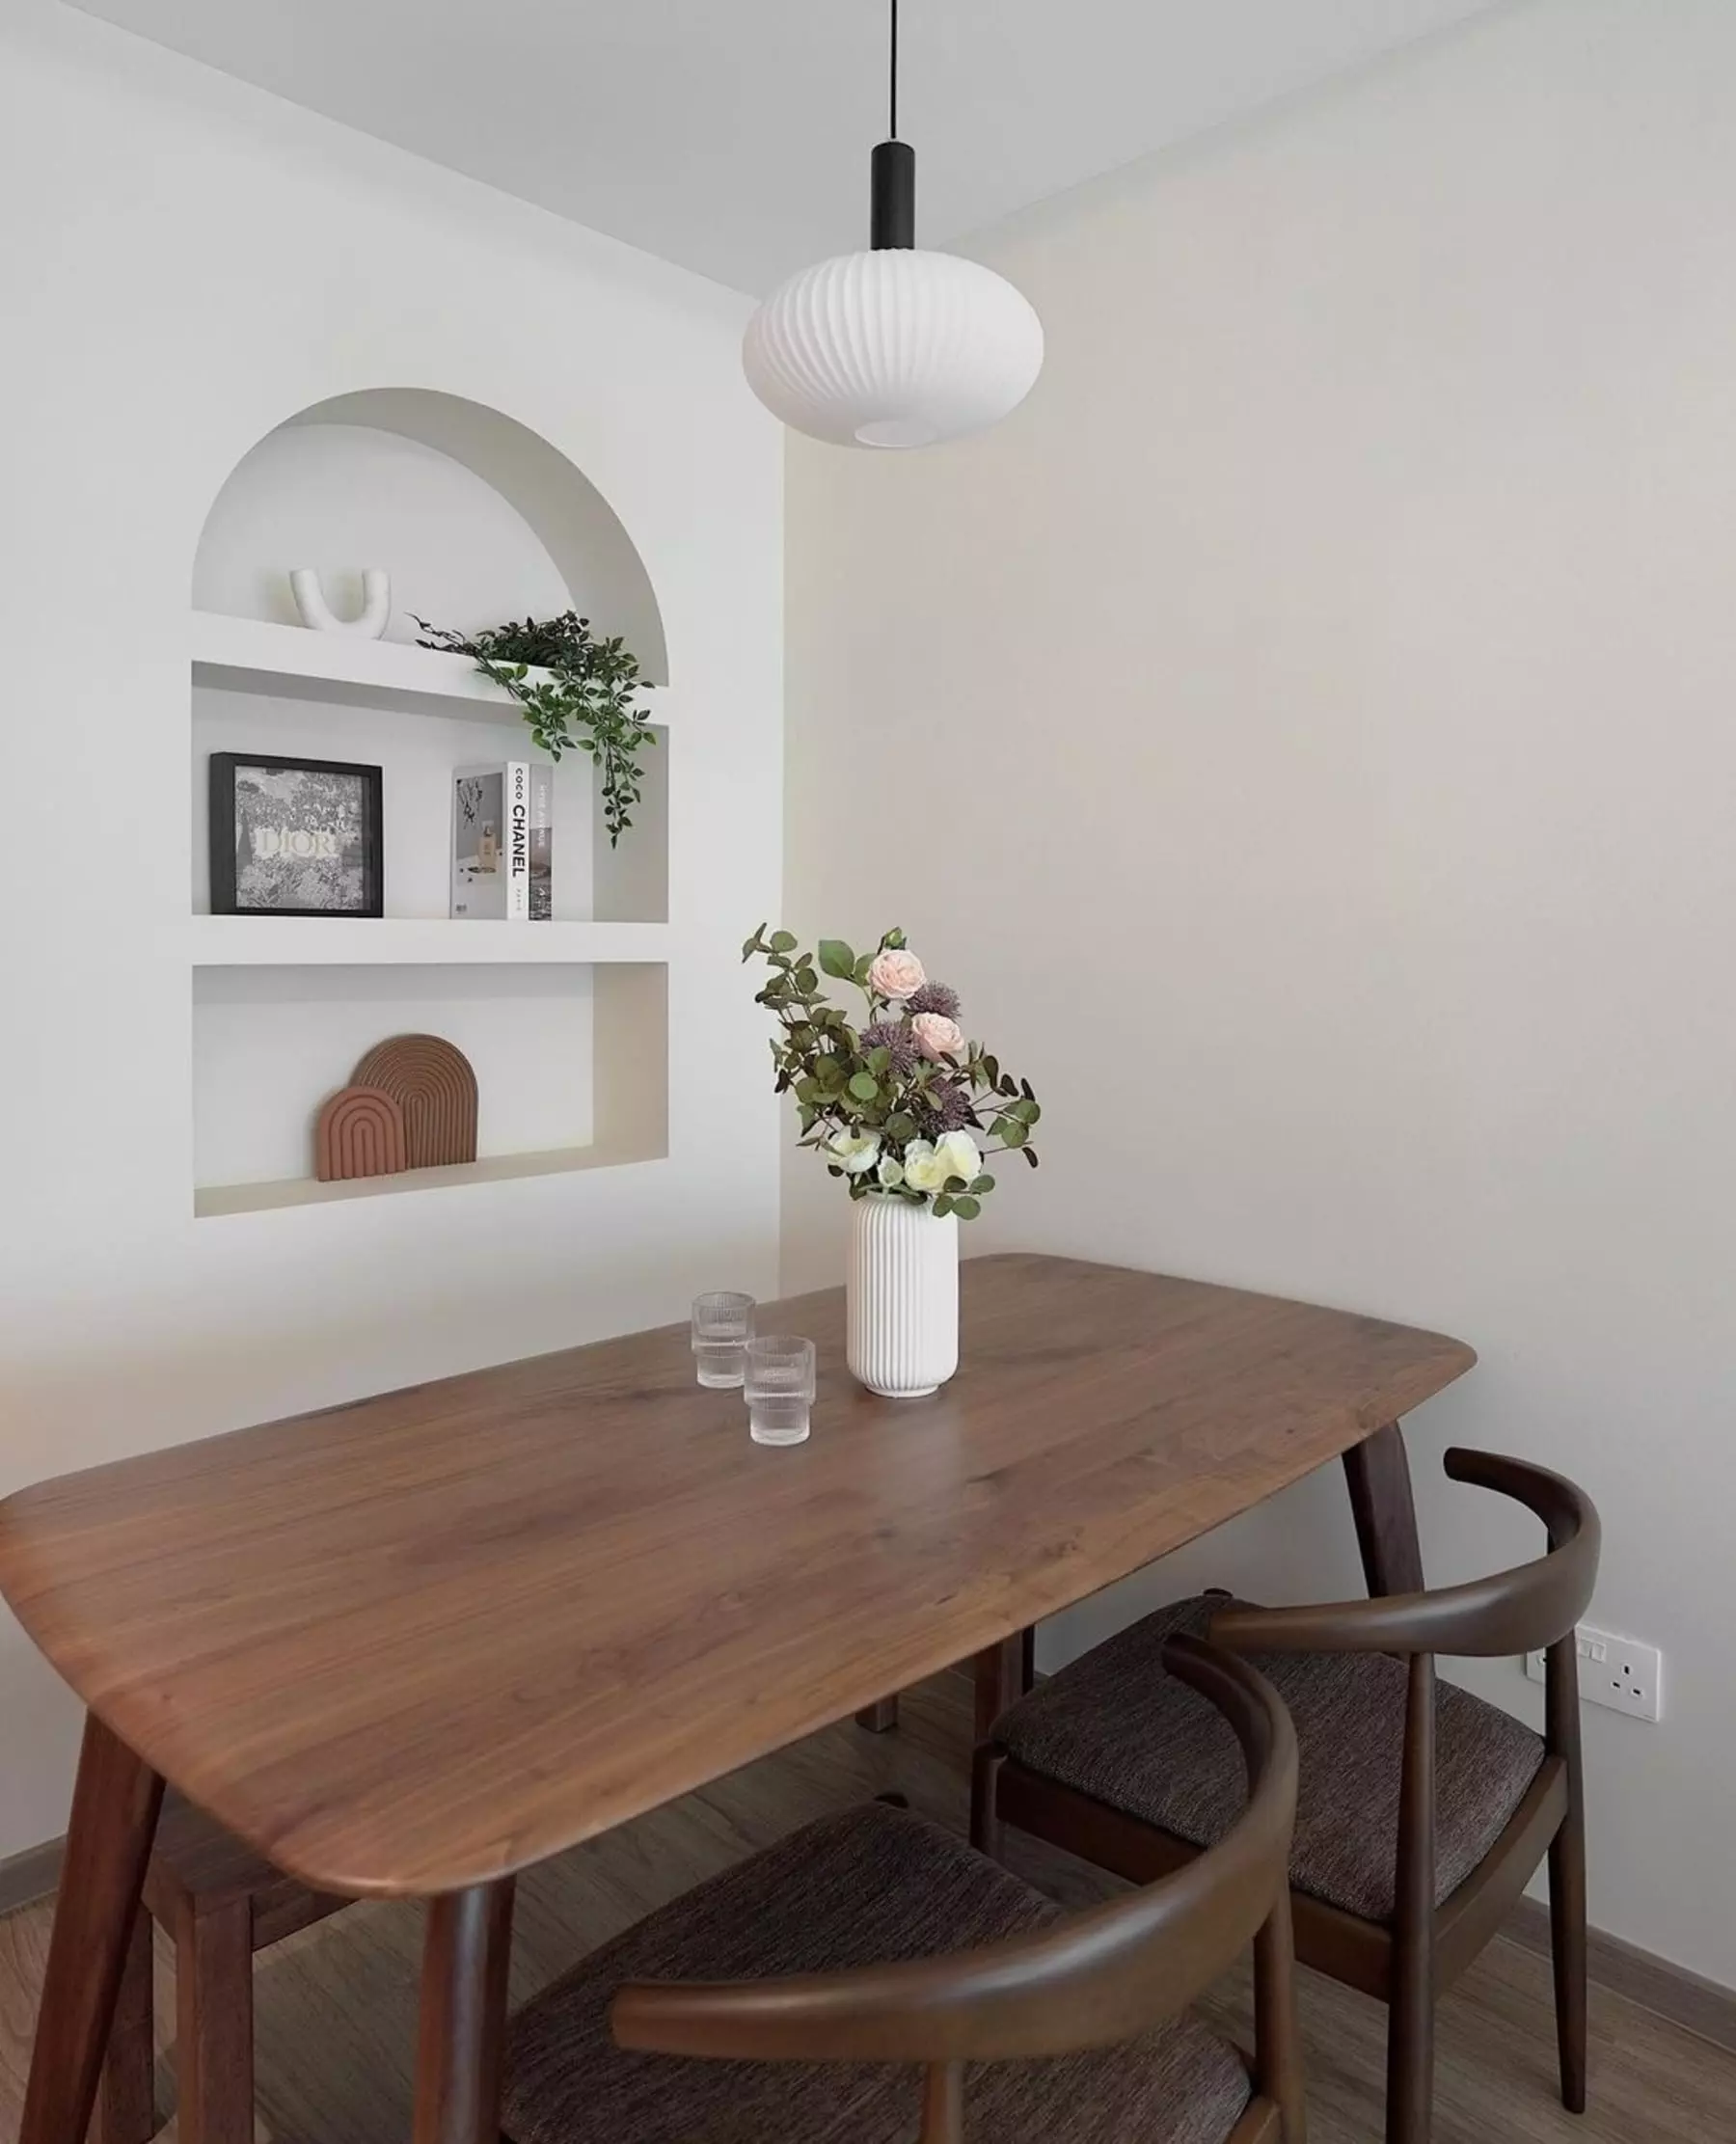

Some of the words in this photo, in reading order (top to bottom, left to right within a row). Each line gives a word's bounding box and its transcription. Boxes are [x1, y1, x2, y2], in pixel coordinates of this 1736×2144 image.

[515, 768, 524, 801] COCO
[261, 829, 334, 855] DIOR
[512, 804, 526, 878] CHANEL
